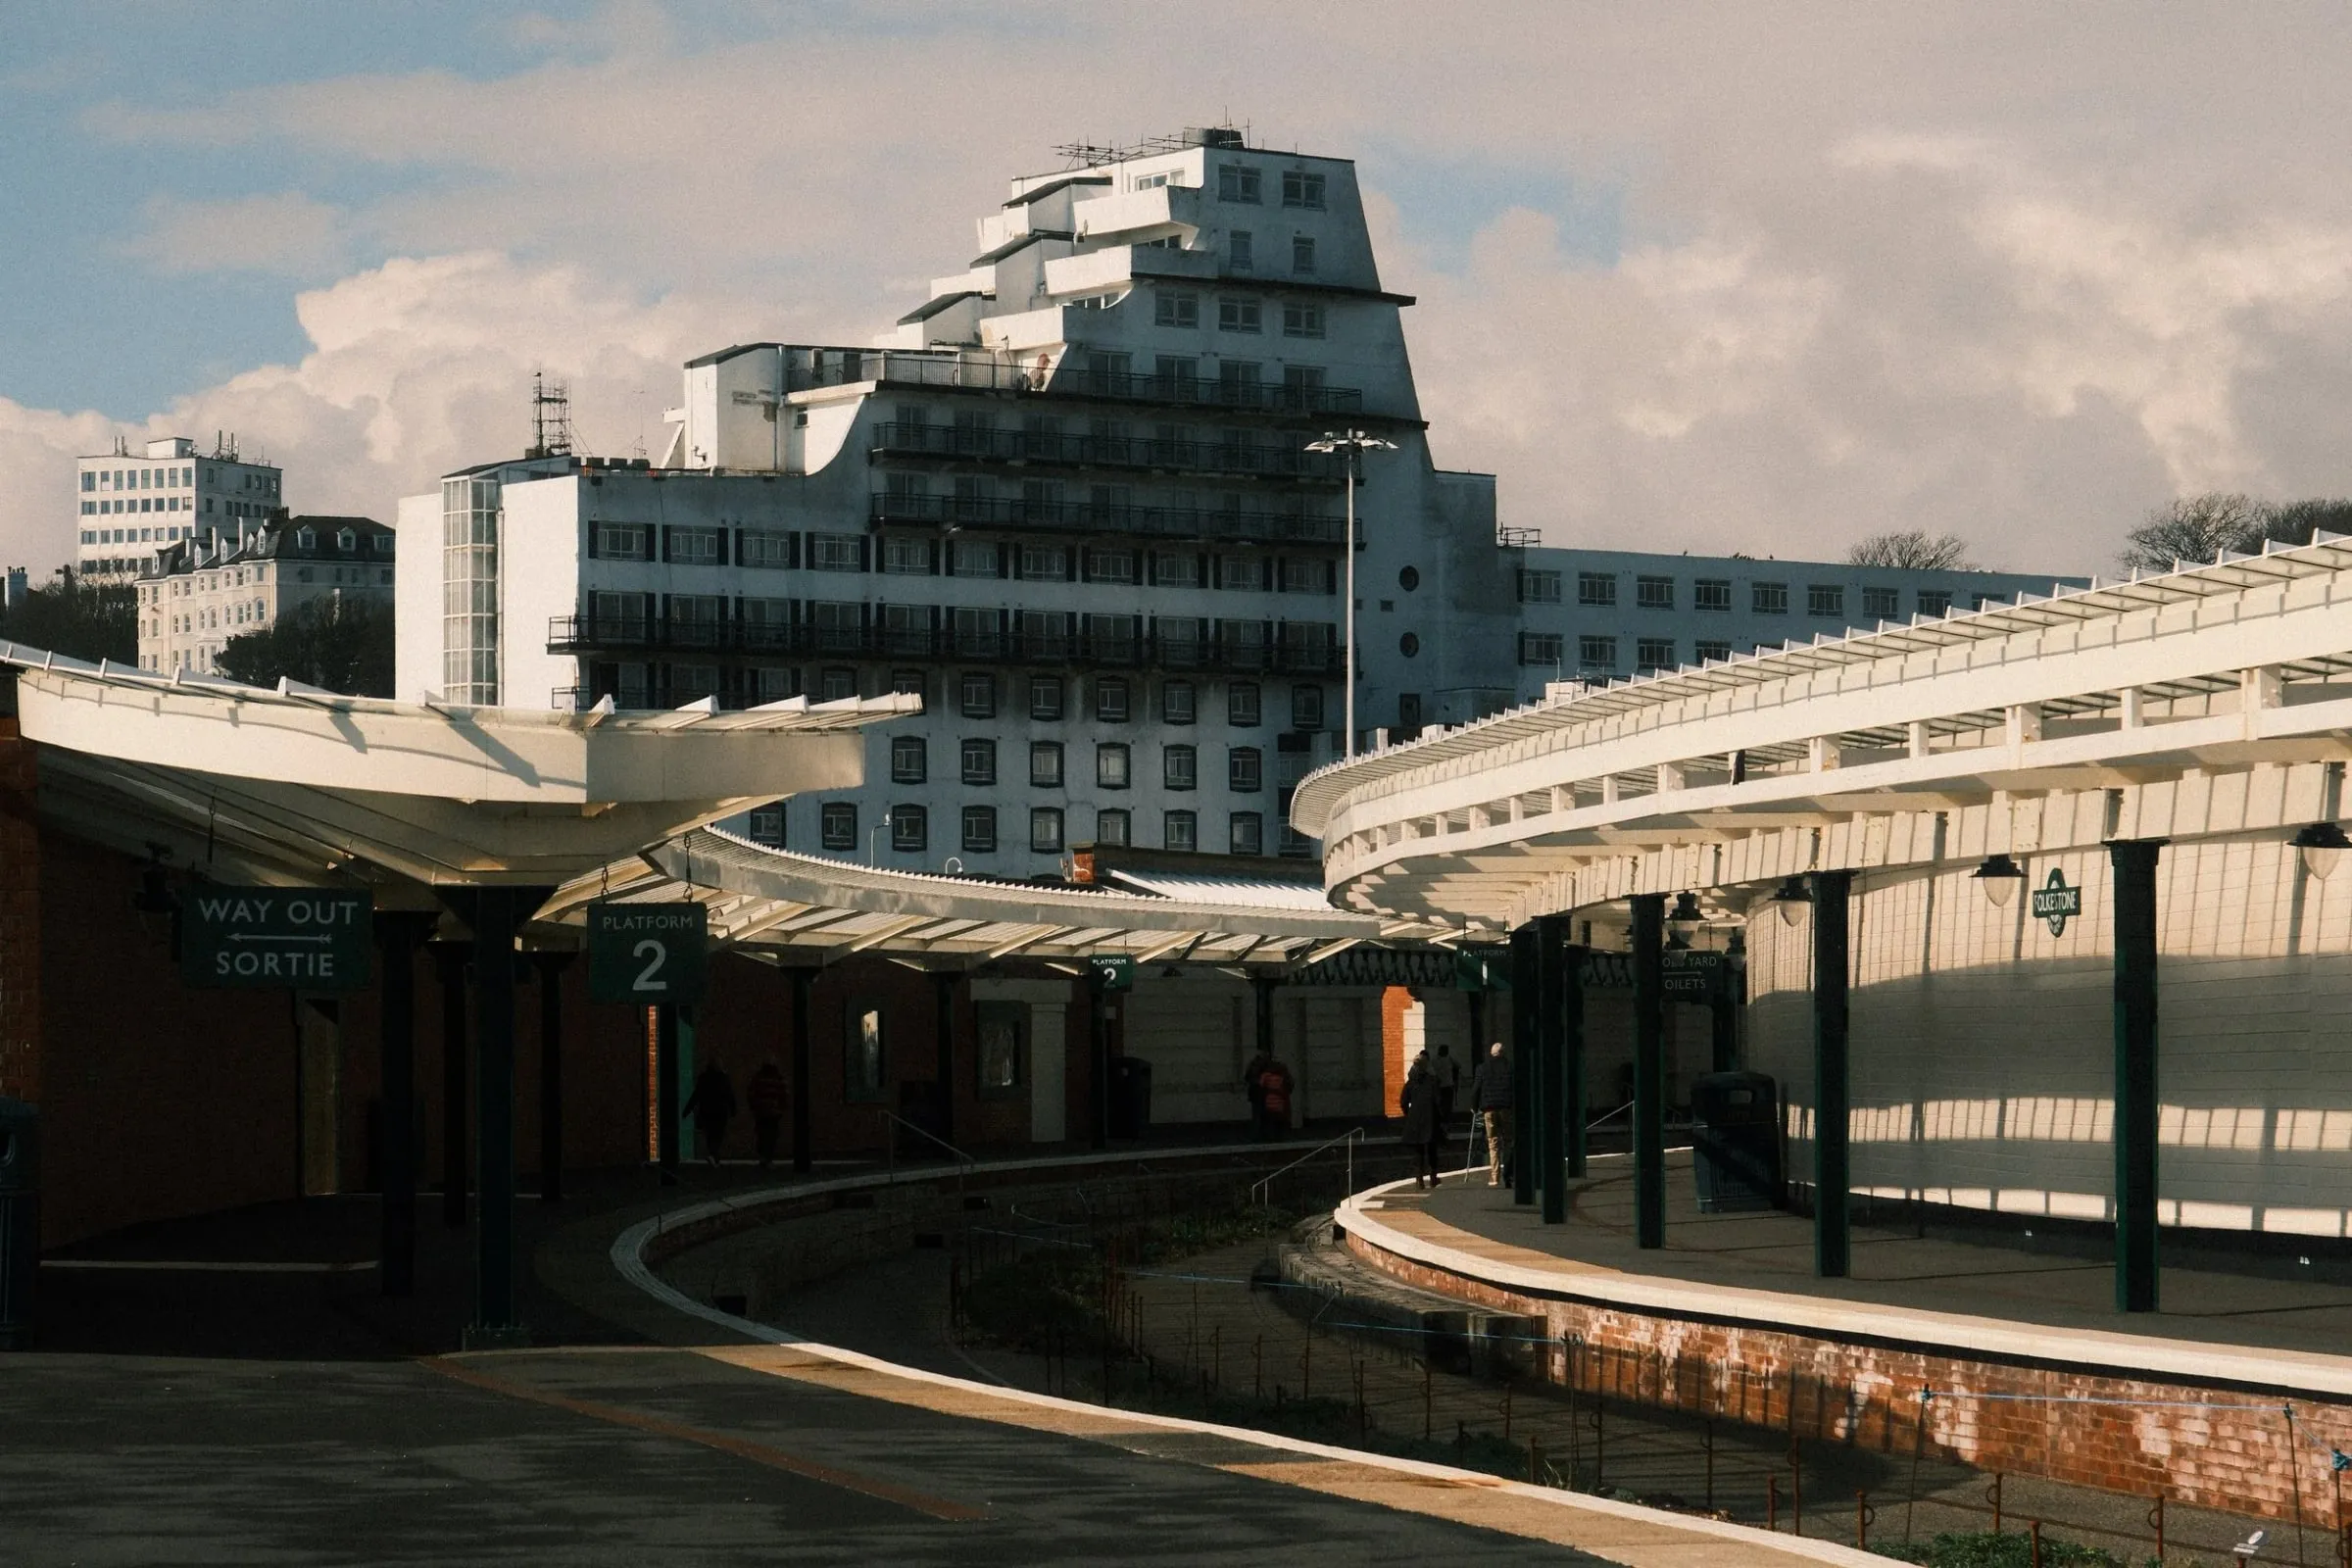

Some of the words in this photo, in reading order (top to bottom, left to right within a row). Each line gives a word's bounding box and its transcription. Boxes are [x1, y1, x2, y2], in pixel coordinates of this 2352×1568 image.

[198, 898, 274, 923] WAY
[287, 900, 360, 925] OUT
[2034, 891, 2077, 912] FOLKESTONE
[603, 915, 694, 930] PLATFORM
[216, 951, 334, 977] SORTIE
[632, 939, 668, 991] 2
[1103, 967, 1117, 989] 2
[1664, 978, 1706, 990] OILETS
